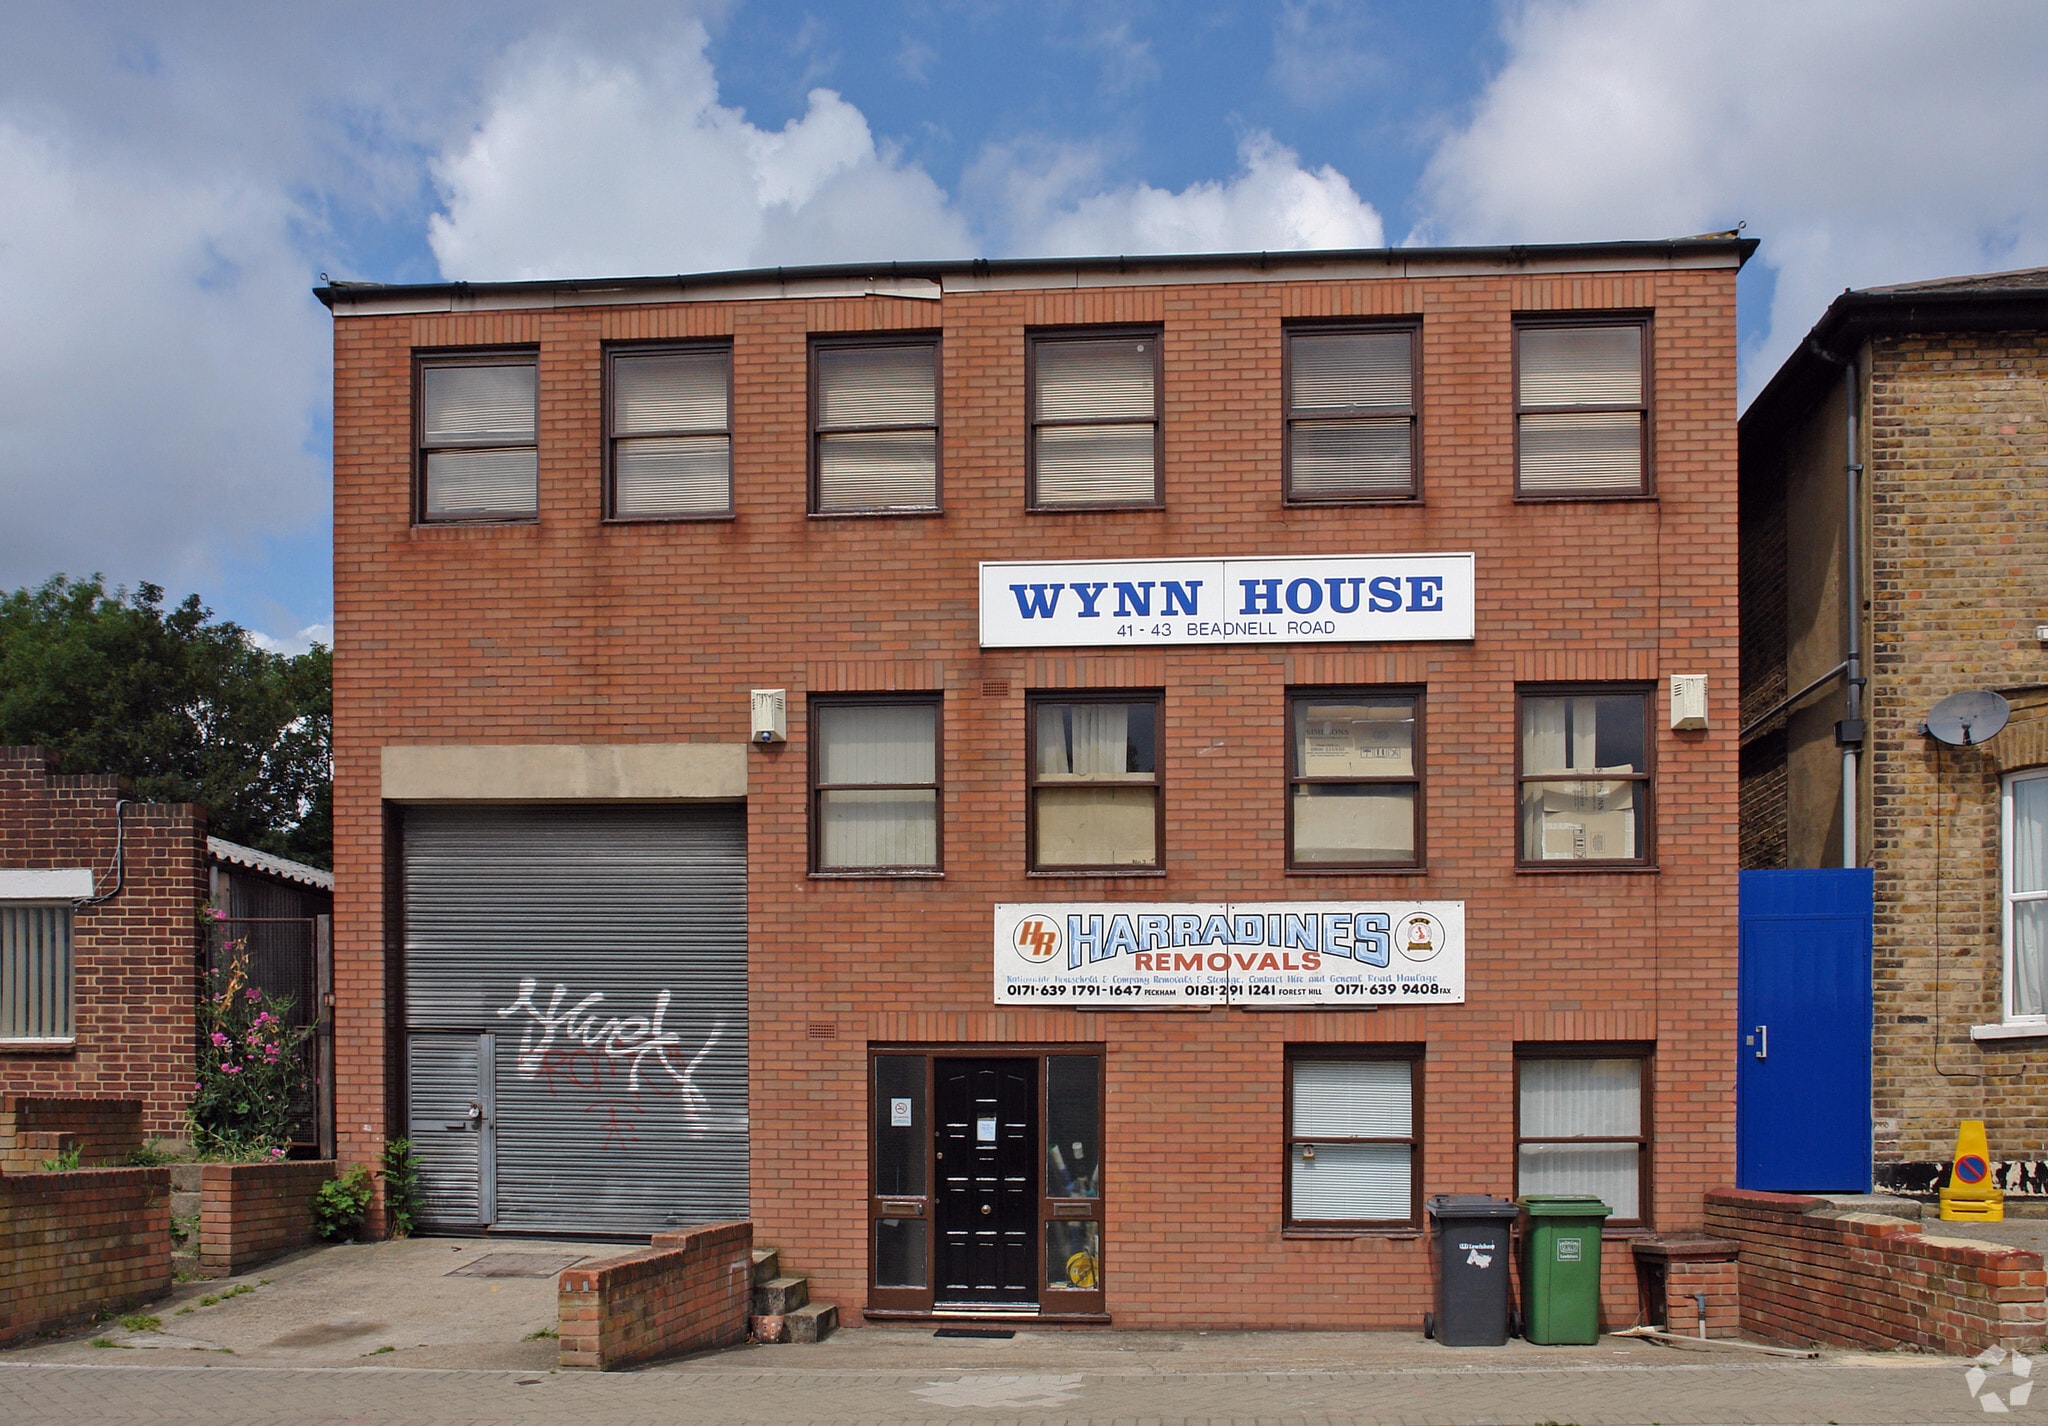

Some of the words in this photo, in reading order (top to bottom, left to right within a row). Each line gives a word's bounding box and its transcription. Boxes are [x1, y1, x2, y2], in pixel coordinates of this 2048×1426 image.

[1008, 580, 1204, 619] WYNN
[1238, 575, 1443, 616] HOUSE
[1116, 624, 1132, 637] 41
[1151, 623, 1171, 636] 43
[1187, 621, 1278, 636] BEADNELL
[1287, 620, 1336, 635] ROAD
[1306, 728, 1349, 736] SIMONS
[1067, 912, 1390, 971] HARRADINES
[1134, 952, 1322, 972] REMOVALS
[1112, 975, 1150, 985] Company
[1153, 975, 1192, 984] Removals
[1248, 975, 1283, 984] Contract
[1287, 975, 1304, 984] Hire
[1308, 975, 1325, 983] and
[1329, 974, 1363, 983] General
[1367, 973, 1392, 983] Road
[1396, 973, 1438, 984] Haulage
[1072, 984, 1142, 996] 1791-1647
[1248, 984, 1276, 996] 1241
[1278, 988, 1307, 996] FOREST
[1401, 983, 1439, 995] 9408
